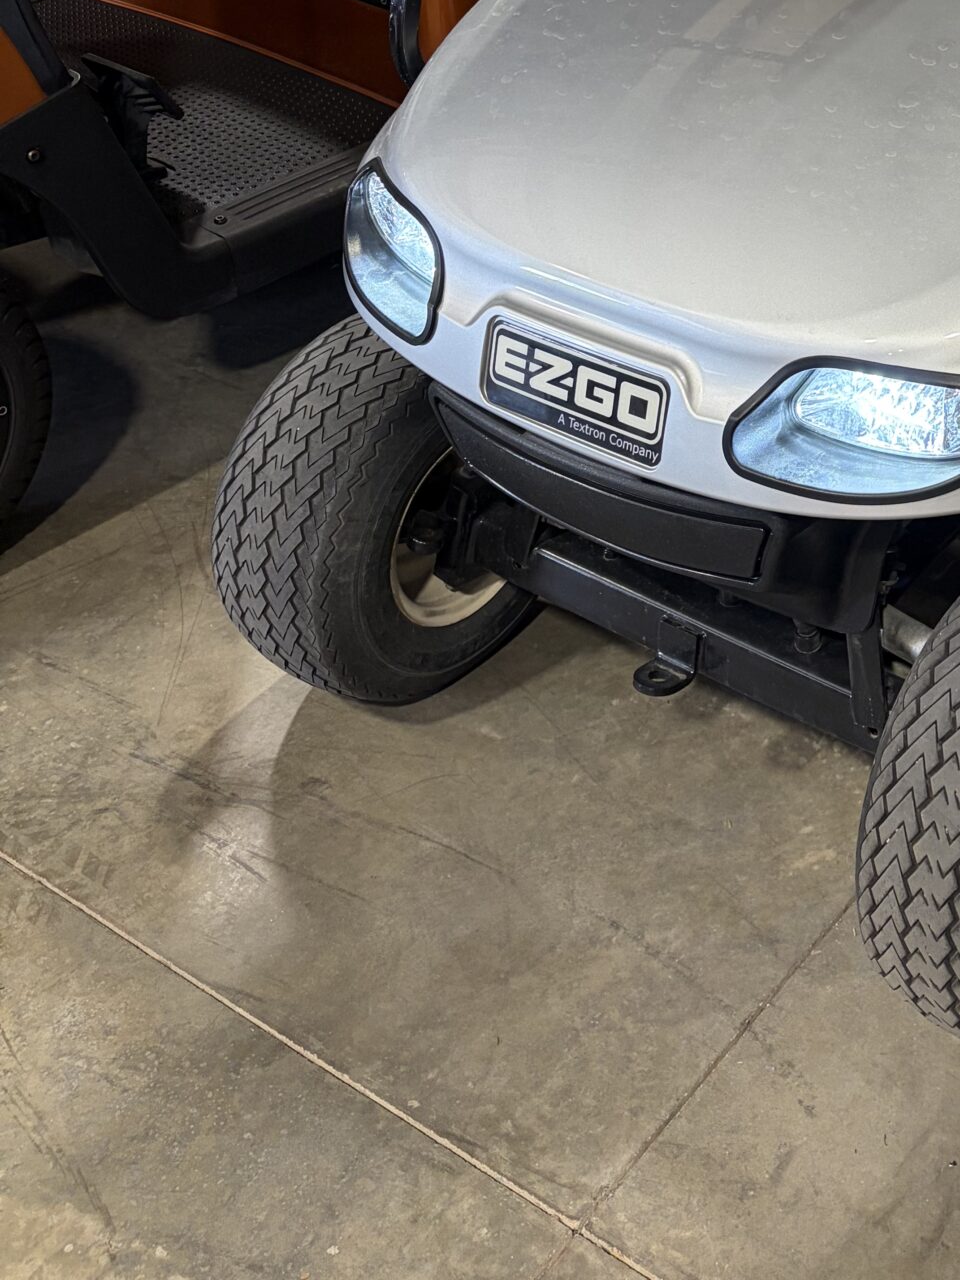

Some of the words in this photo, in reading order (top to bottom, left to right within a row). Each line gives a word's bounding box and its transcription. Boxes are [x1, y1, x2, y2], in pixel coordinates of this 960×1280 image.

[494, 334, 661, 435] EZGO
[557, 413, 566, 426] A
[568, 416, 606, 442] Textron
[608, 433, 660, 464] Company
